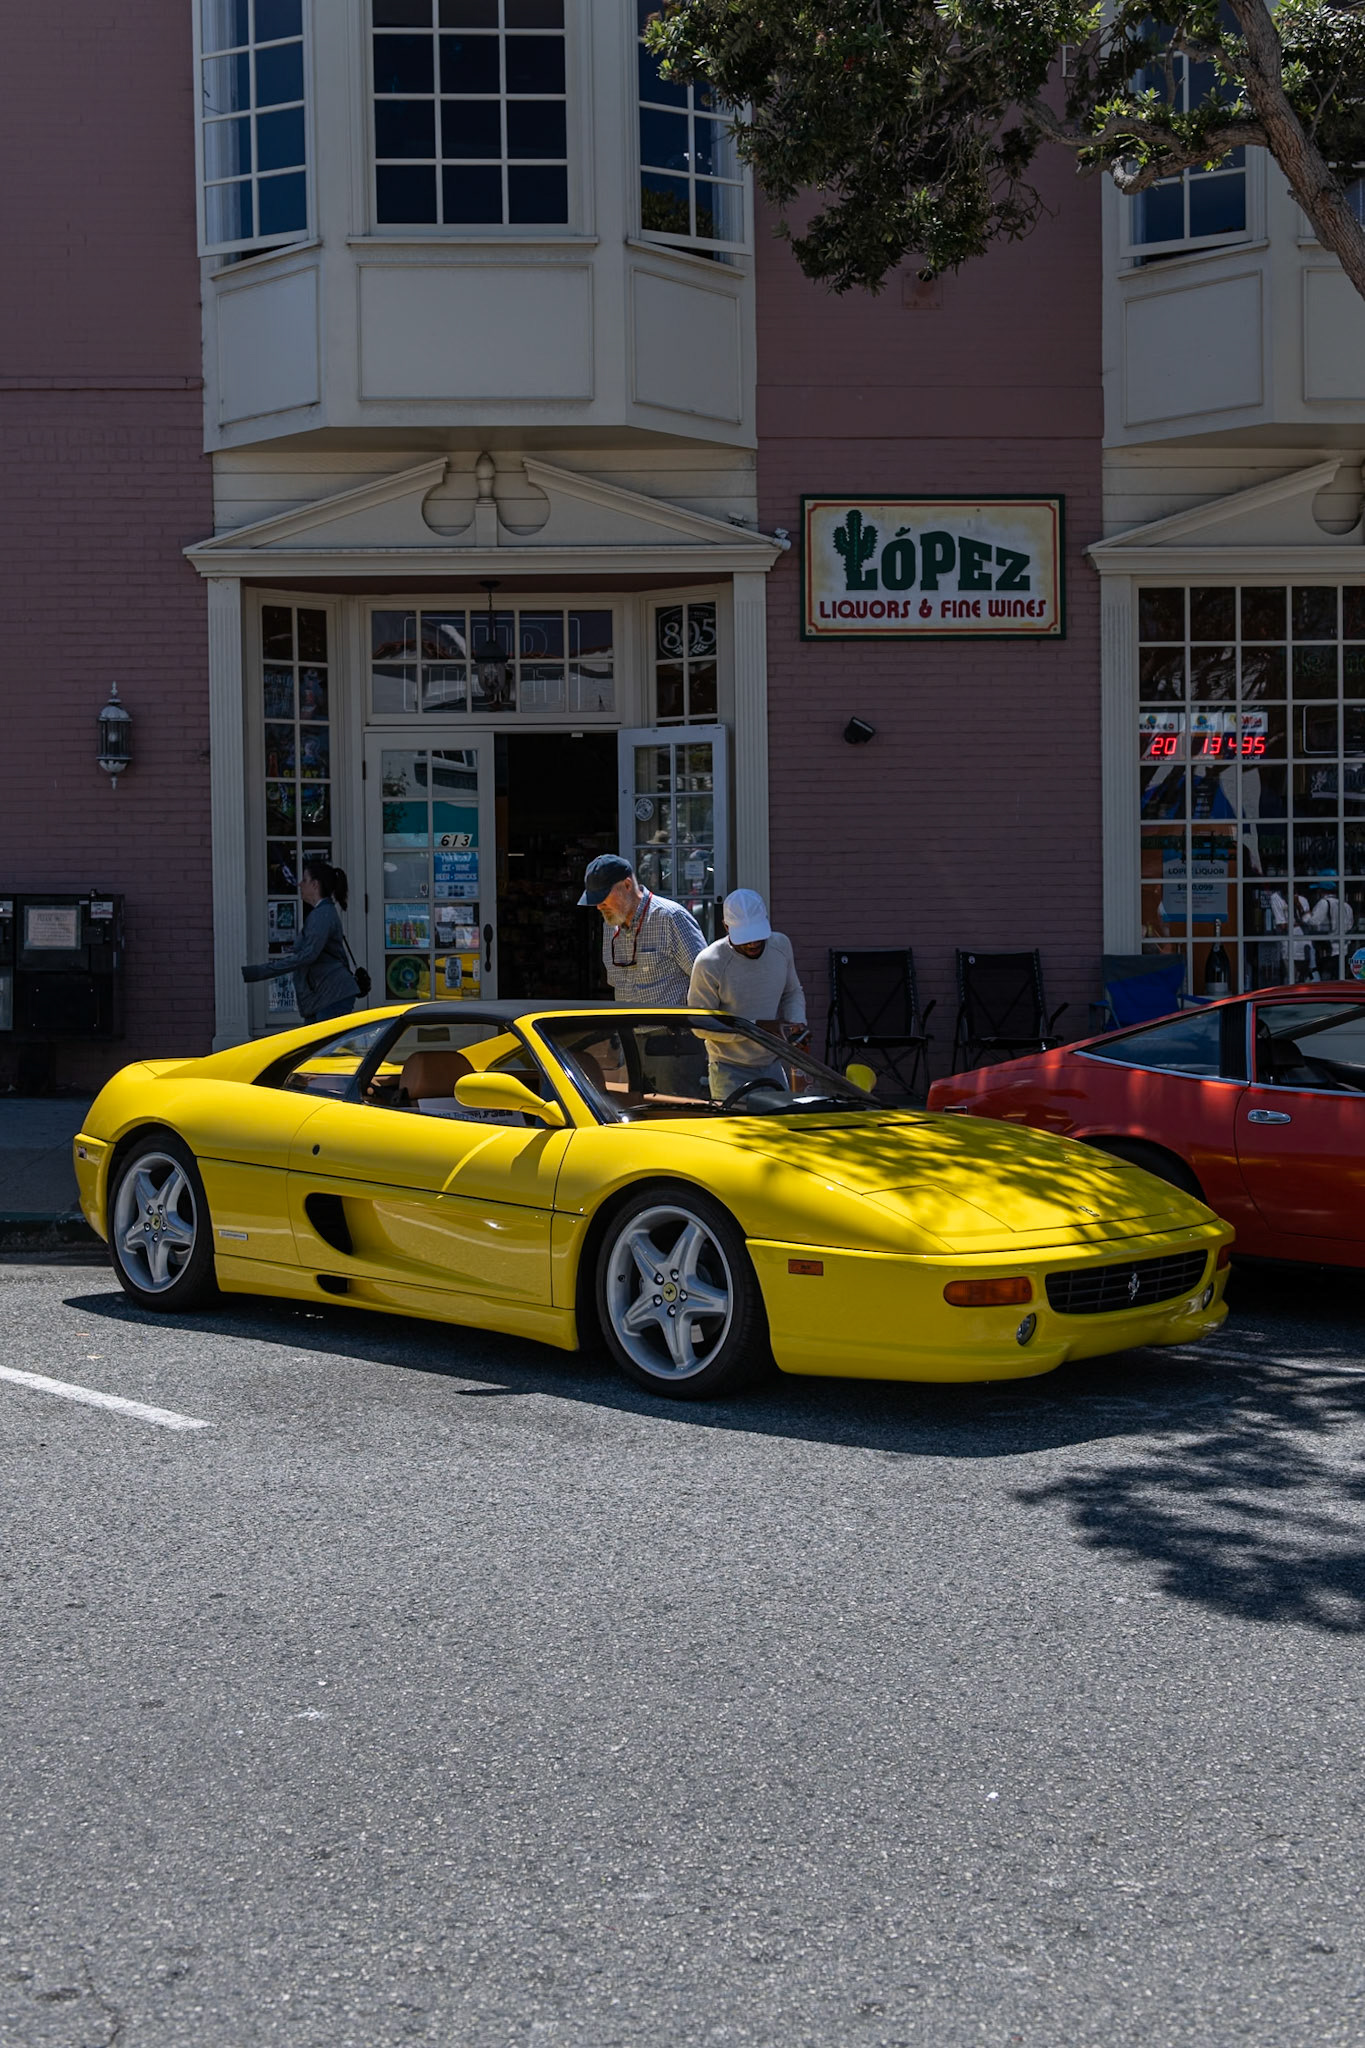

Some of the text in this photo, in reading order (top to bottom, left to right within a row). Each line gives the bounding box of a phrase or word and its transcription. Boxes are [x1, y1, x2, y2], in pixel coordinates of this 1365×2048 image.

[819, 598, 1047, 619] LIQUORS & FINE WINES
[662, 618, 716, 649] 805
[1151, 737, 1177, 755] 20
[1203, 737, 1222, 755] 13
[283, 770, 319, 778] GAT
[441, 834, 470, 846] 613
